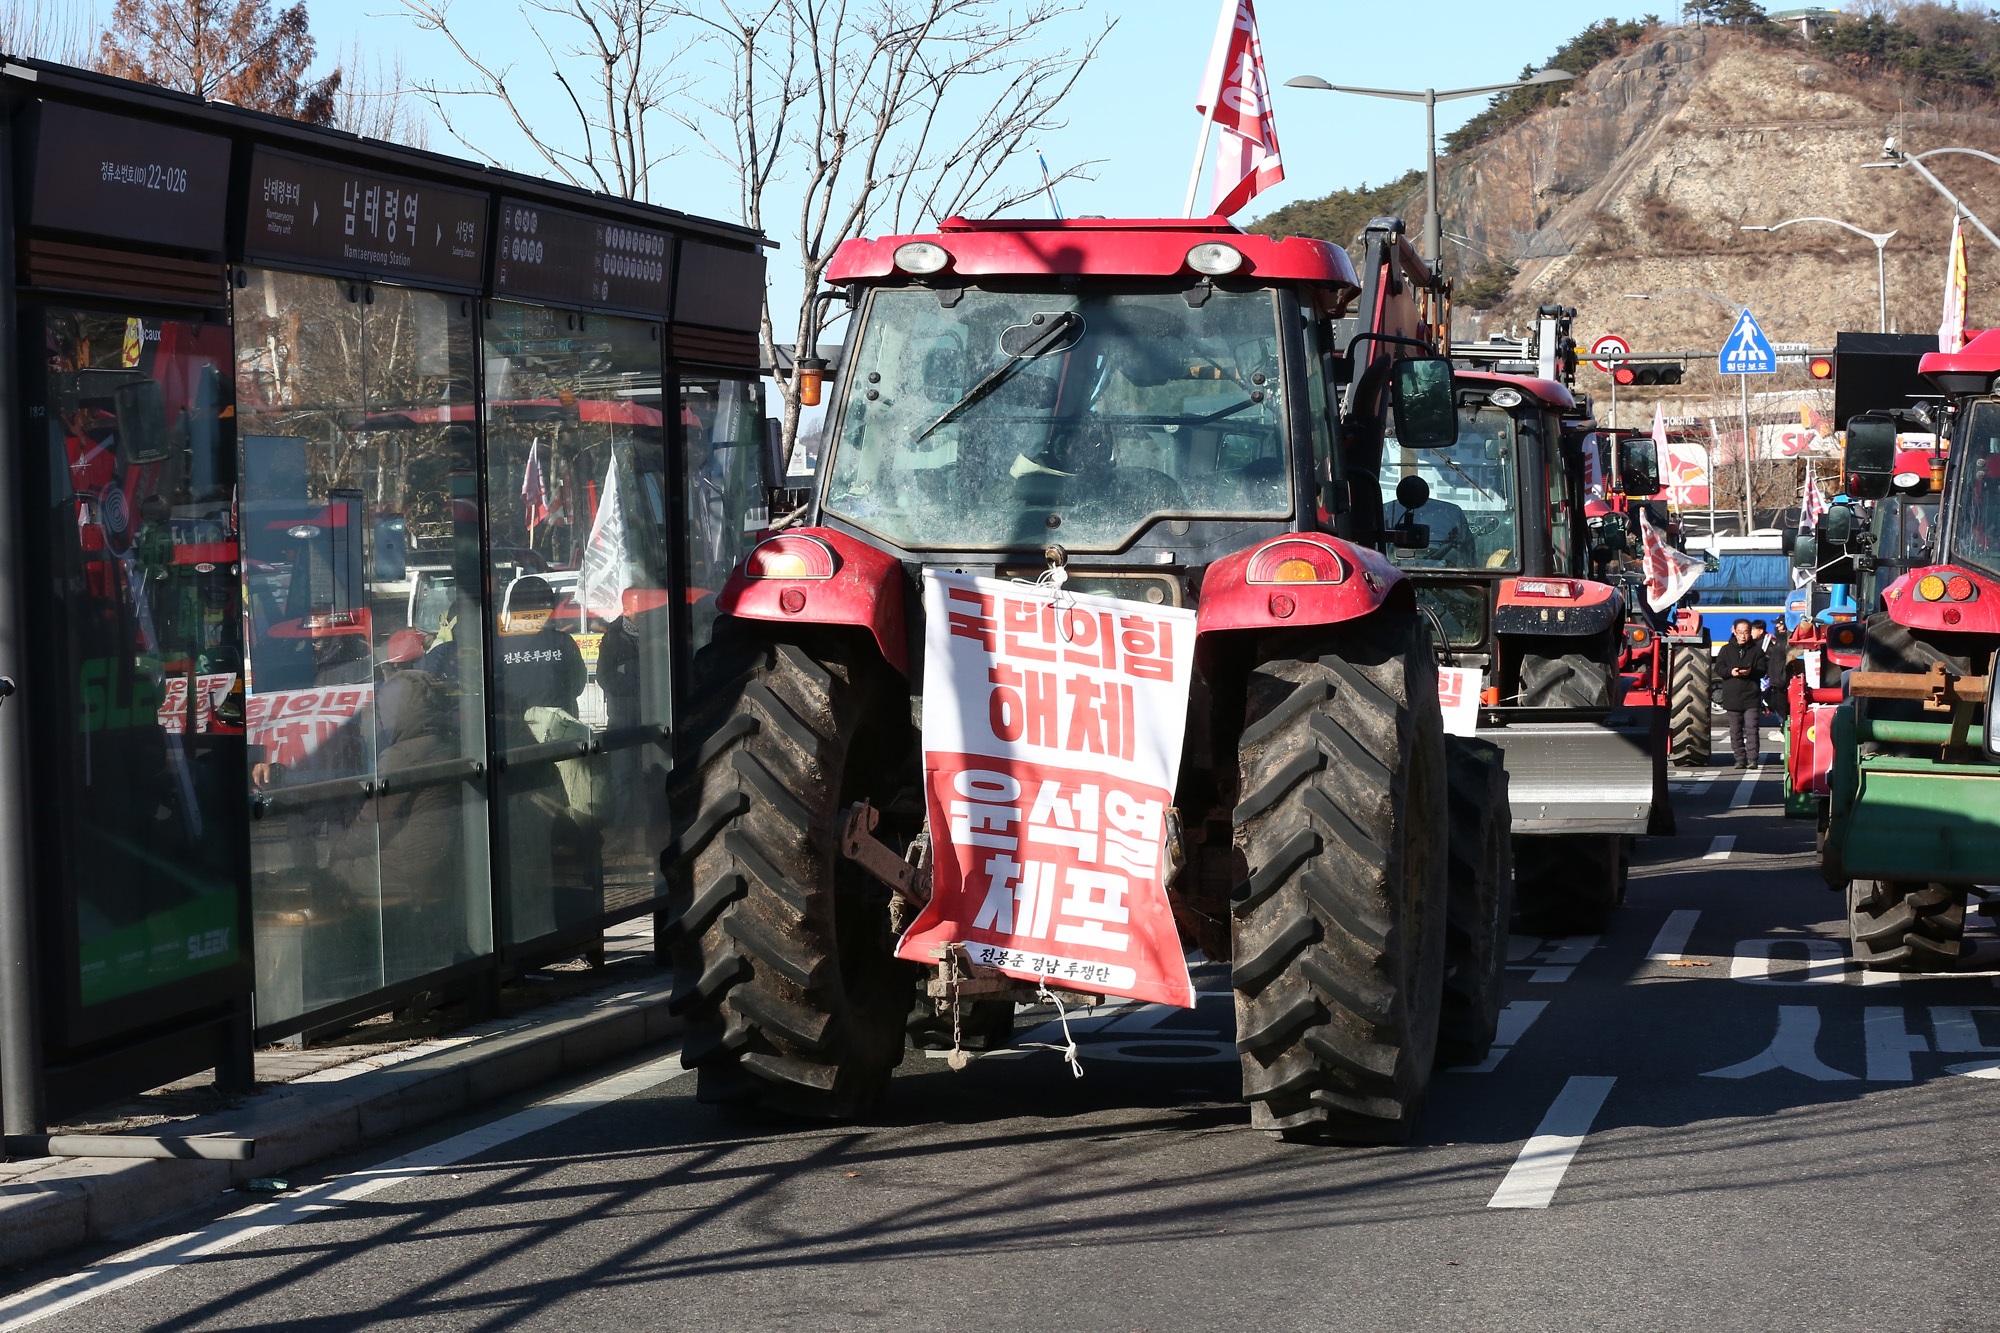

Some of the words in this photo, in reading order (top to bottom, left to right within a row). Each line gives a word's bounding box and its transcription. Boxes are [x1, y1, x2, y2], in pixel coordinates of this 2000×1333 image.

[101, 161, 147, 185] 정류소번호(ID)
[147, 164, 187, 193] 22-026
[263, 178, 300, 206] 남태령부대
[343, 181, 419, 246] 남태령역
[456, 220, 475, 244] 사당역
[344, 243, 388, 266] Namtaeryeong
[389, 250, 411, 267] Station
[1726, 362, 1768, 371] 횡단보도
[1781, 431, 1814, 456] SK
[1665, 486, 1692, 505] SK
[948, 587, 1173, 683] 국민의힘
[504, 649, 562, 665] 전봉준투쟁단
[989, 667, 1136, 761] 해체
[951, 769, 1162, 879] 윤석열
[973, 858, 1130, 953] 체포
[188, 927, 230, 960] SLEEK
[979, 947, 1026, 969] 전봉준
[1031, 955, 1061, 977] 경남
[1063, 961, 1111, 984] 투쟁단
